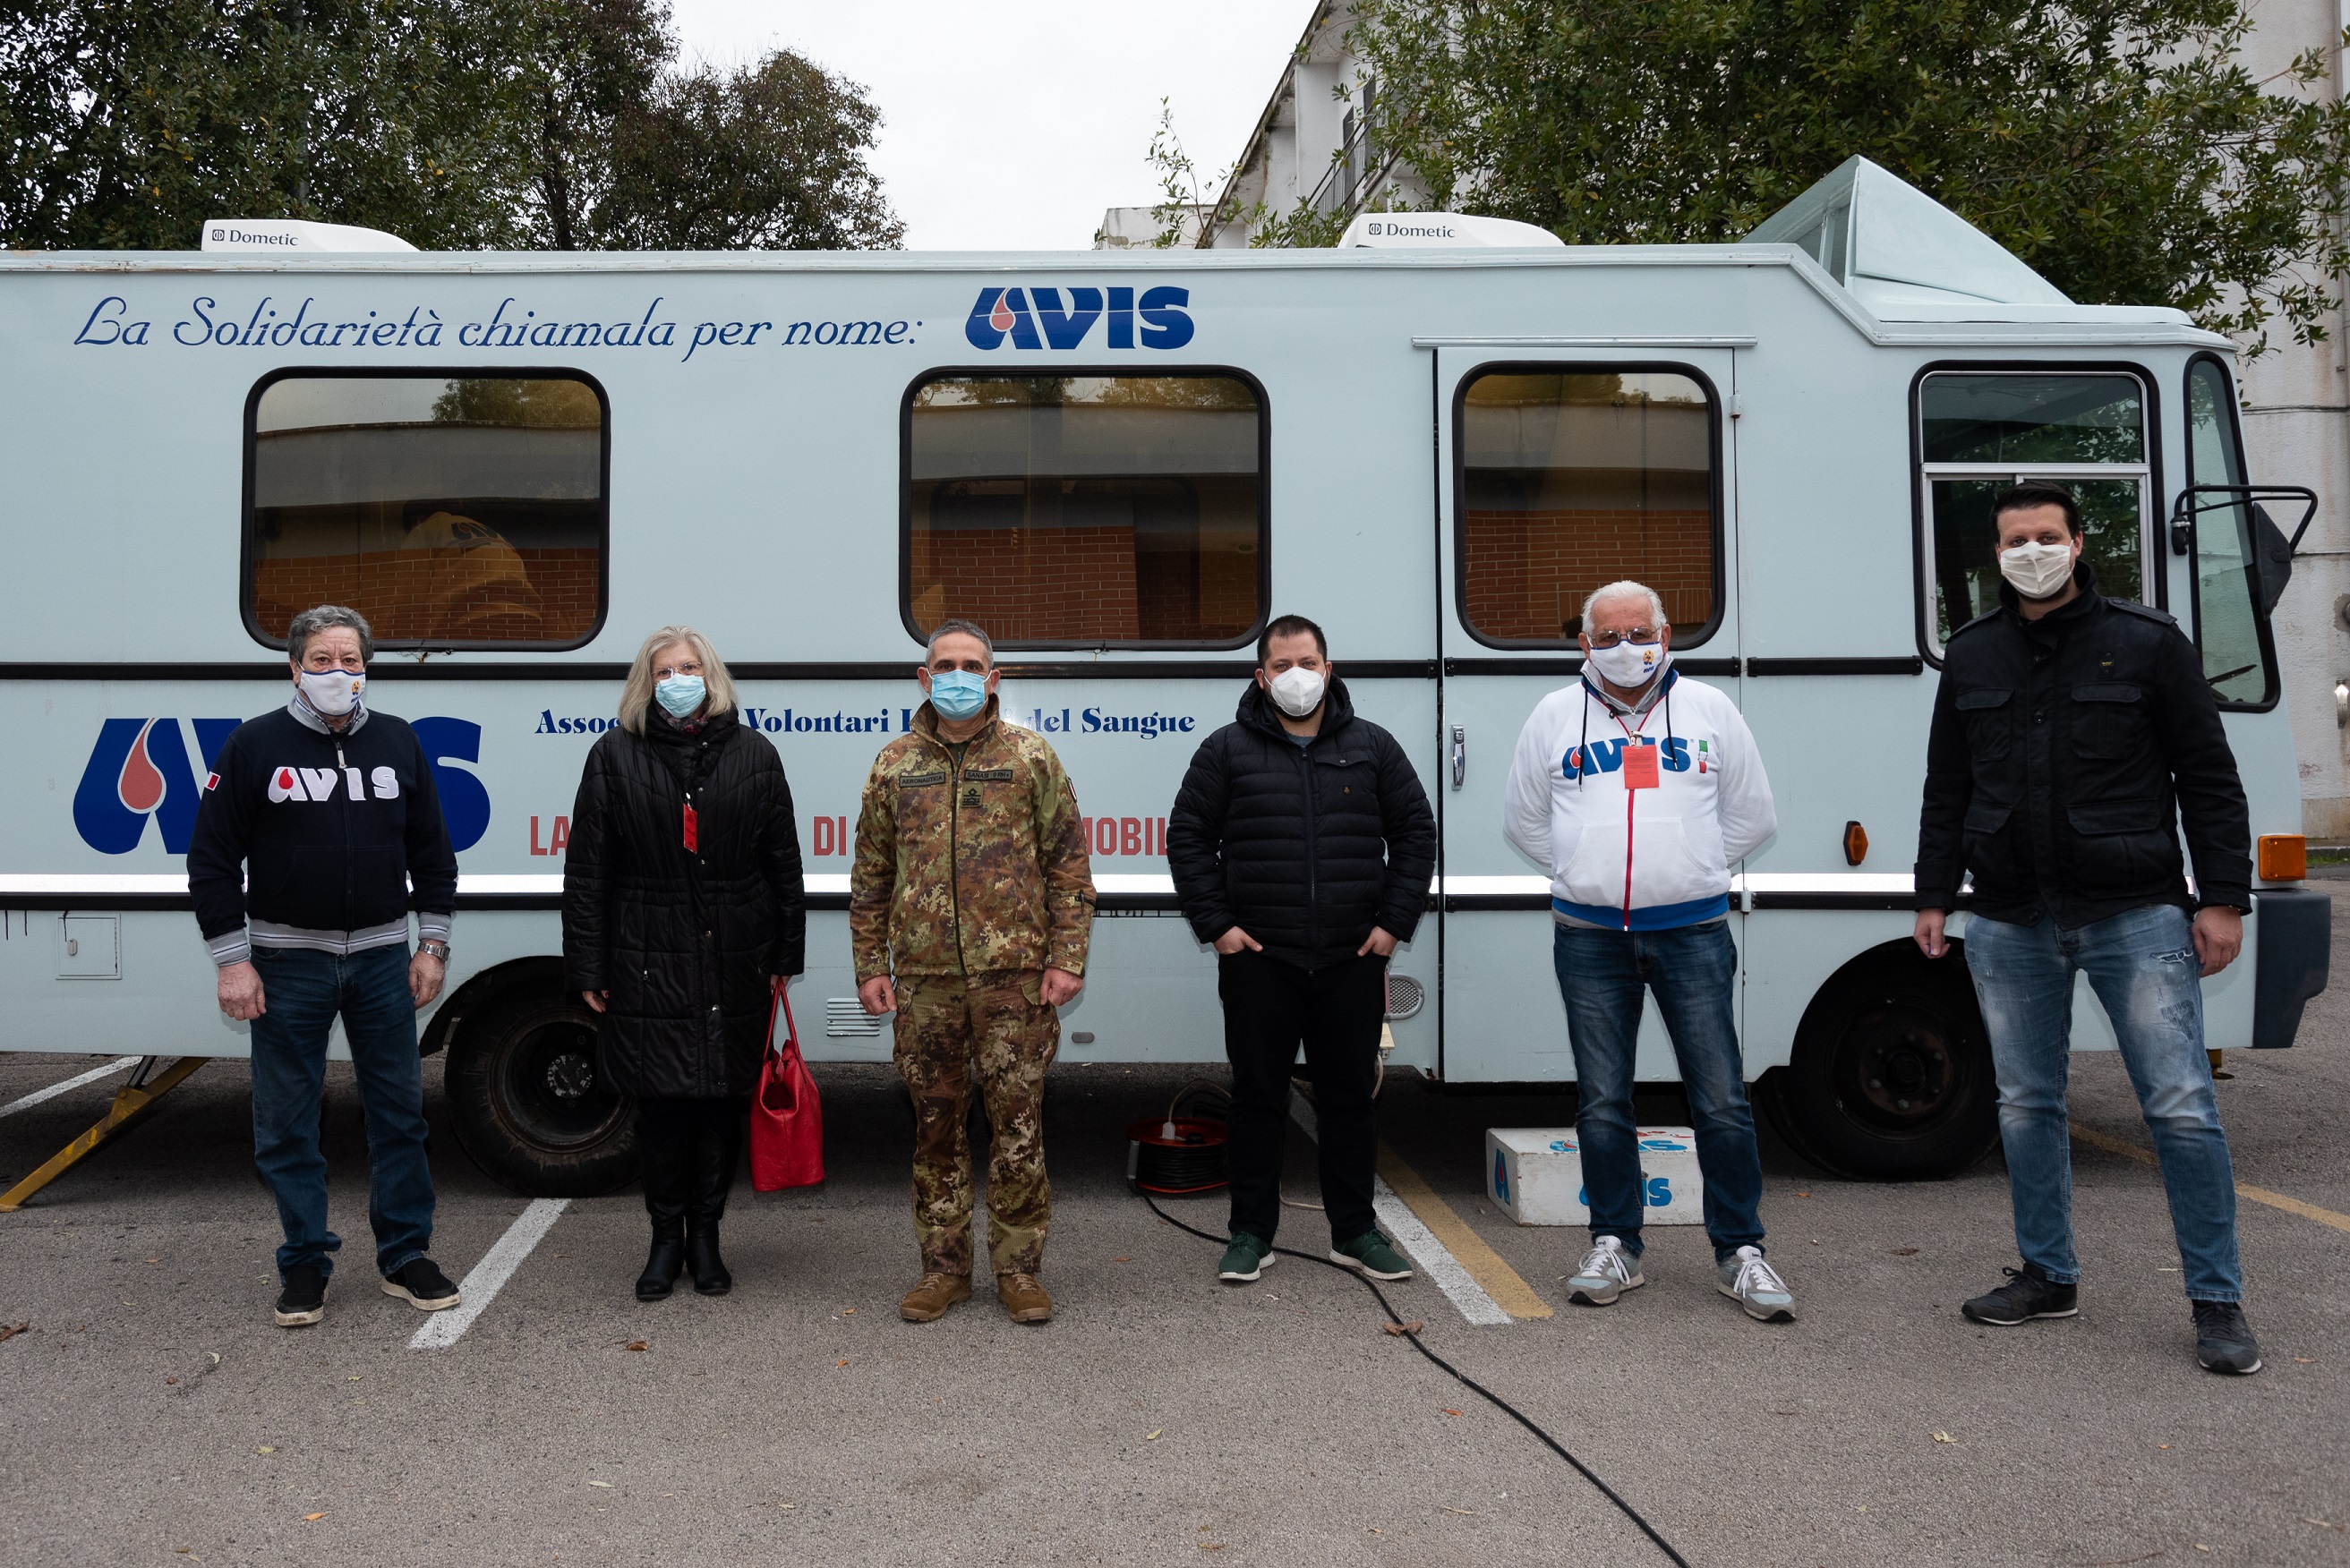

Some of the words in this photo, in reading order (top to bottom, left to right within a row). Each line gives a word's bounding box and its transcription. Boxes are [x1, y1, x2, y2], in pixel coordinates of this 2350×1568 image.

[229, 230, 298, 246] Dometic
[1387, 222, 1456, 238] Dometic
[73, 296, 150, 345] La
[173, 296, 444, 347] Solidarietà
[458, 297, 677, 347] chiamala
[681, 321, 773, 362] per
[782, 320, 924, 345] nome:
[965, 285, 1195, 351] AVIS
[744, 708, 890, 733] Volontari
[1023, 708, 1071, 733] del
[1081, 707, 1195, 739] Sangue
[268, 766, 399, 804] AVIS
[902, 776, 943, 785] AERONAUTICA
[813, 815, 847, 856] DI
